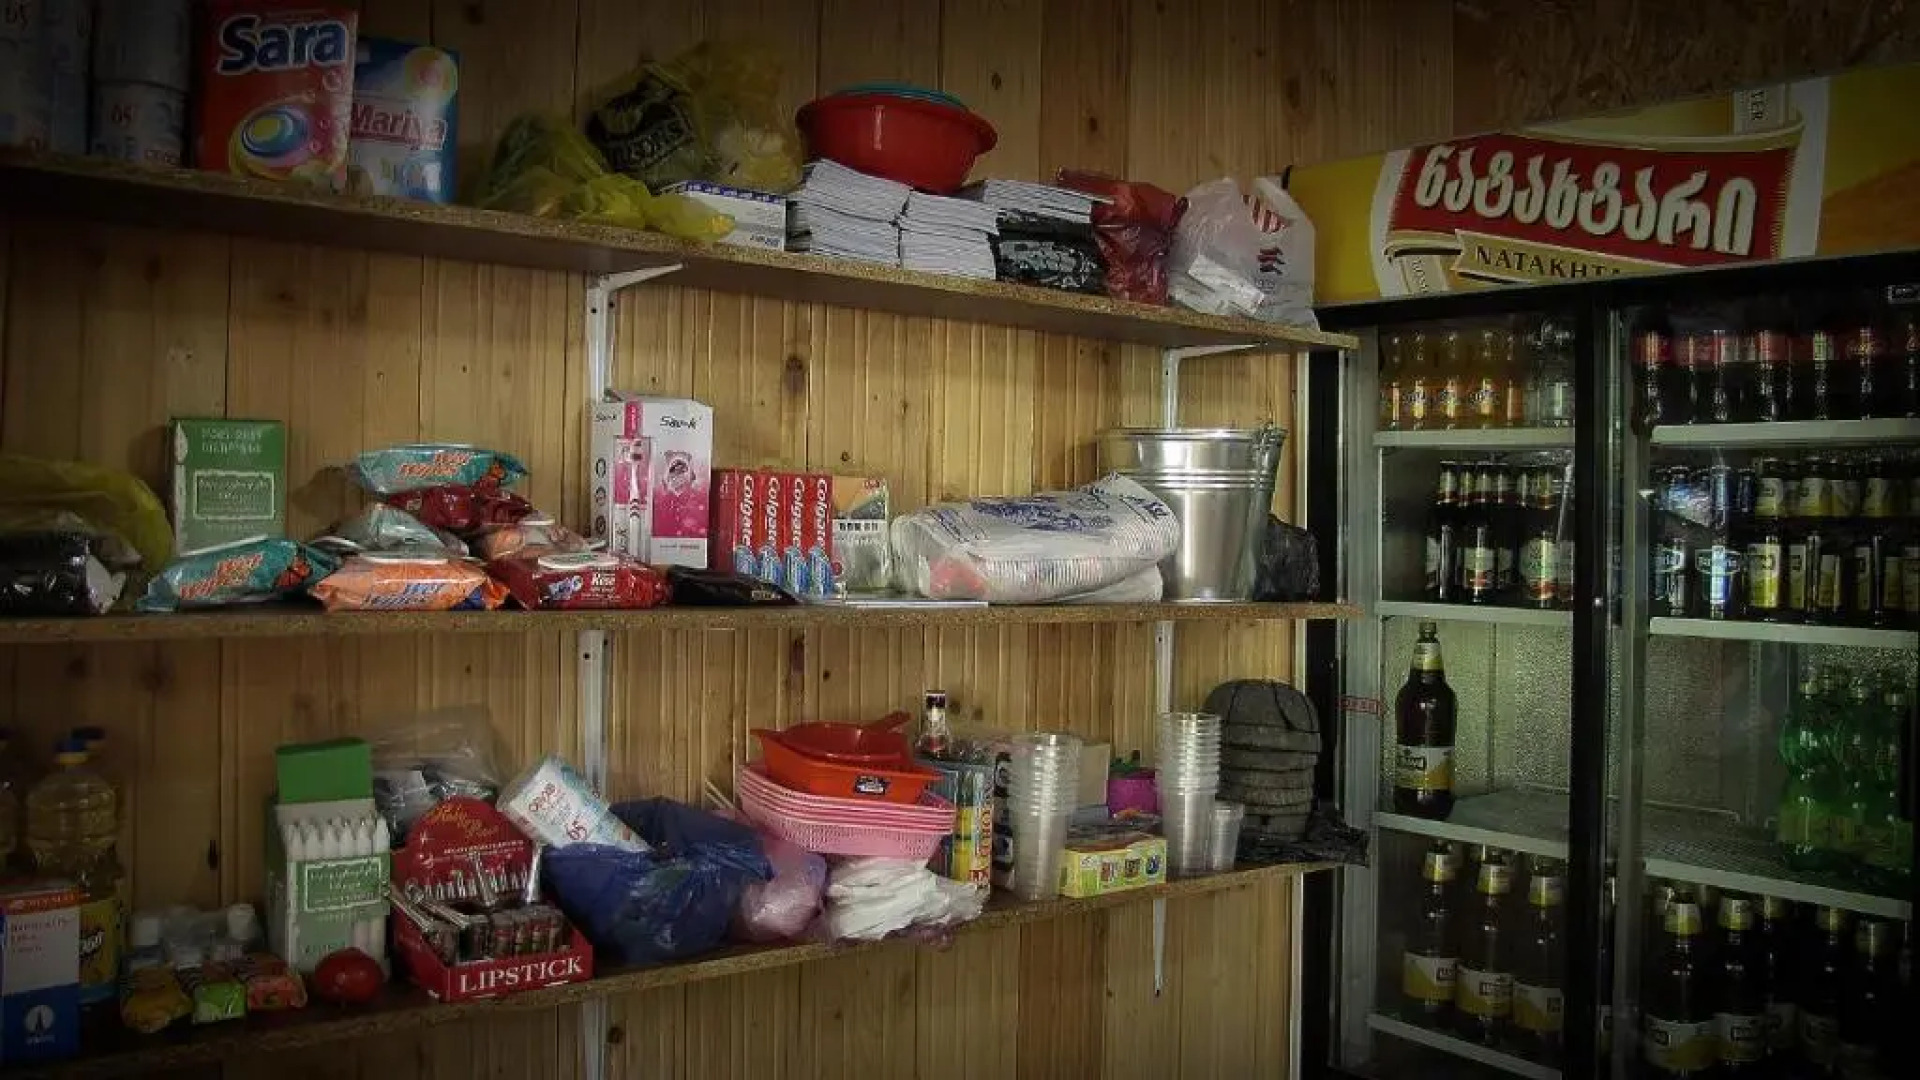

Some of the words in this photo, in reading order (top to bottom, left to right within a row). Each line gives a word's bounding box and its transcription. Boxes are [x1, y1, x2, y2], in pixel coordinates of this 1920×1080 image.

[217, 15, 348, 75] Sara
[1414, 145, 1758, 256] ნატახტარი
[1476, 244, 1621, 279] NATAKHT
[459, 954, 584, 993] LIPSTICK
